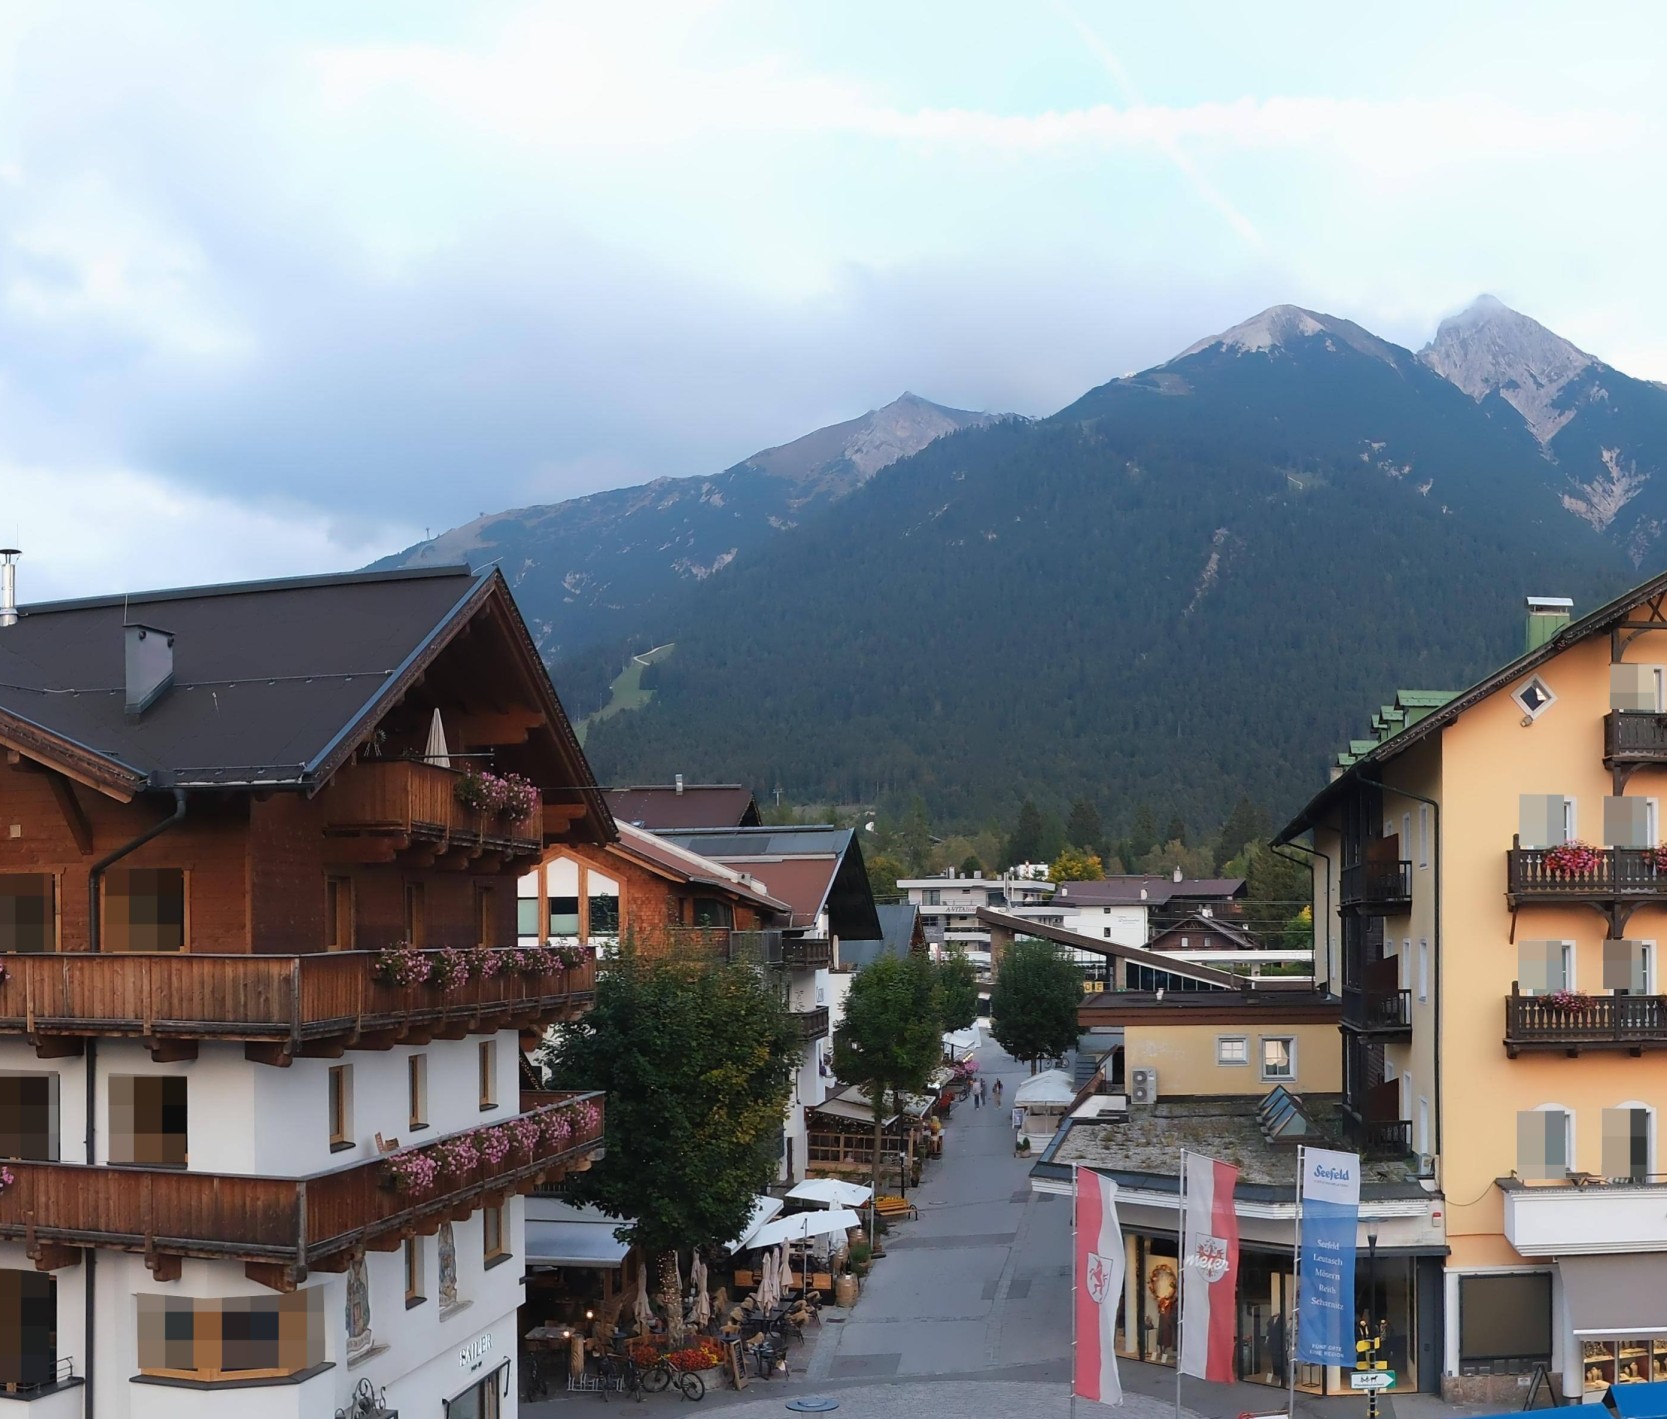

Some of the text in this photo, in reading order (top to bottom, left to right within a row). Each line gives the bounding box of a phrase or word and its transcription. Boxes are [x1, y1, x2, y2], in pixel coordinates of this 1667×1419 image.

[1313, 1164, 1350, 1181] Seefeld
[1317, 1239, 1340, 1250] Seefeld
[1313, 1252, 1343, 1266] Leutasch
[1315, 1267, 1341, 1281] Mösern
[1318, 1282, 1337, 1294] Reith
[1311, 1296, 1344, 1311] Scharnitz
